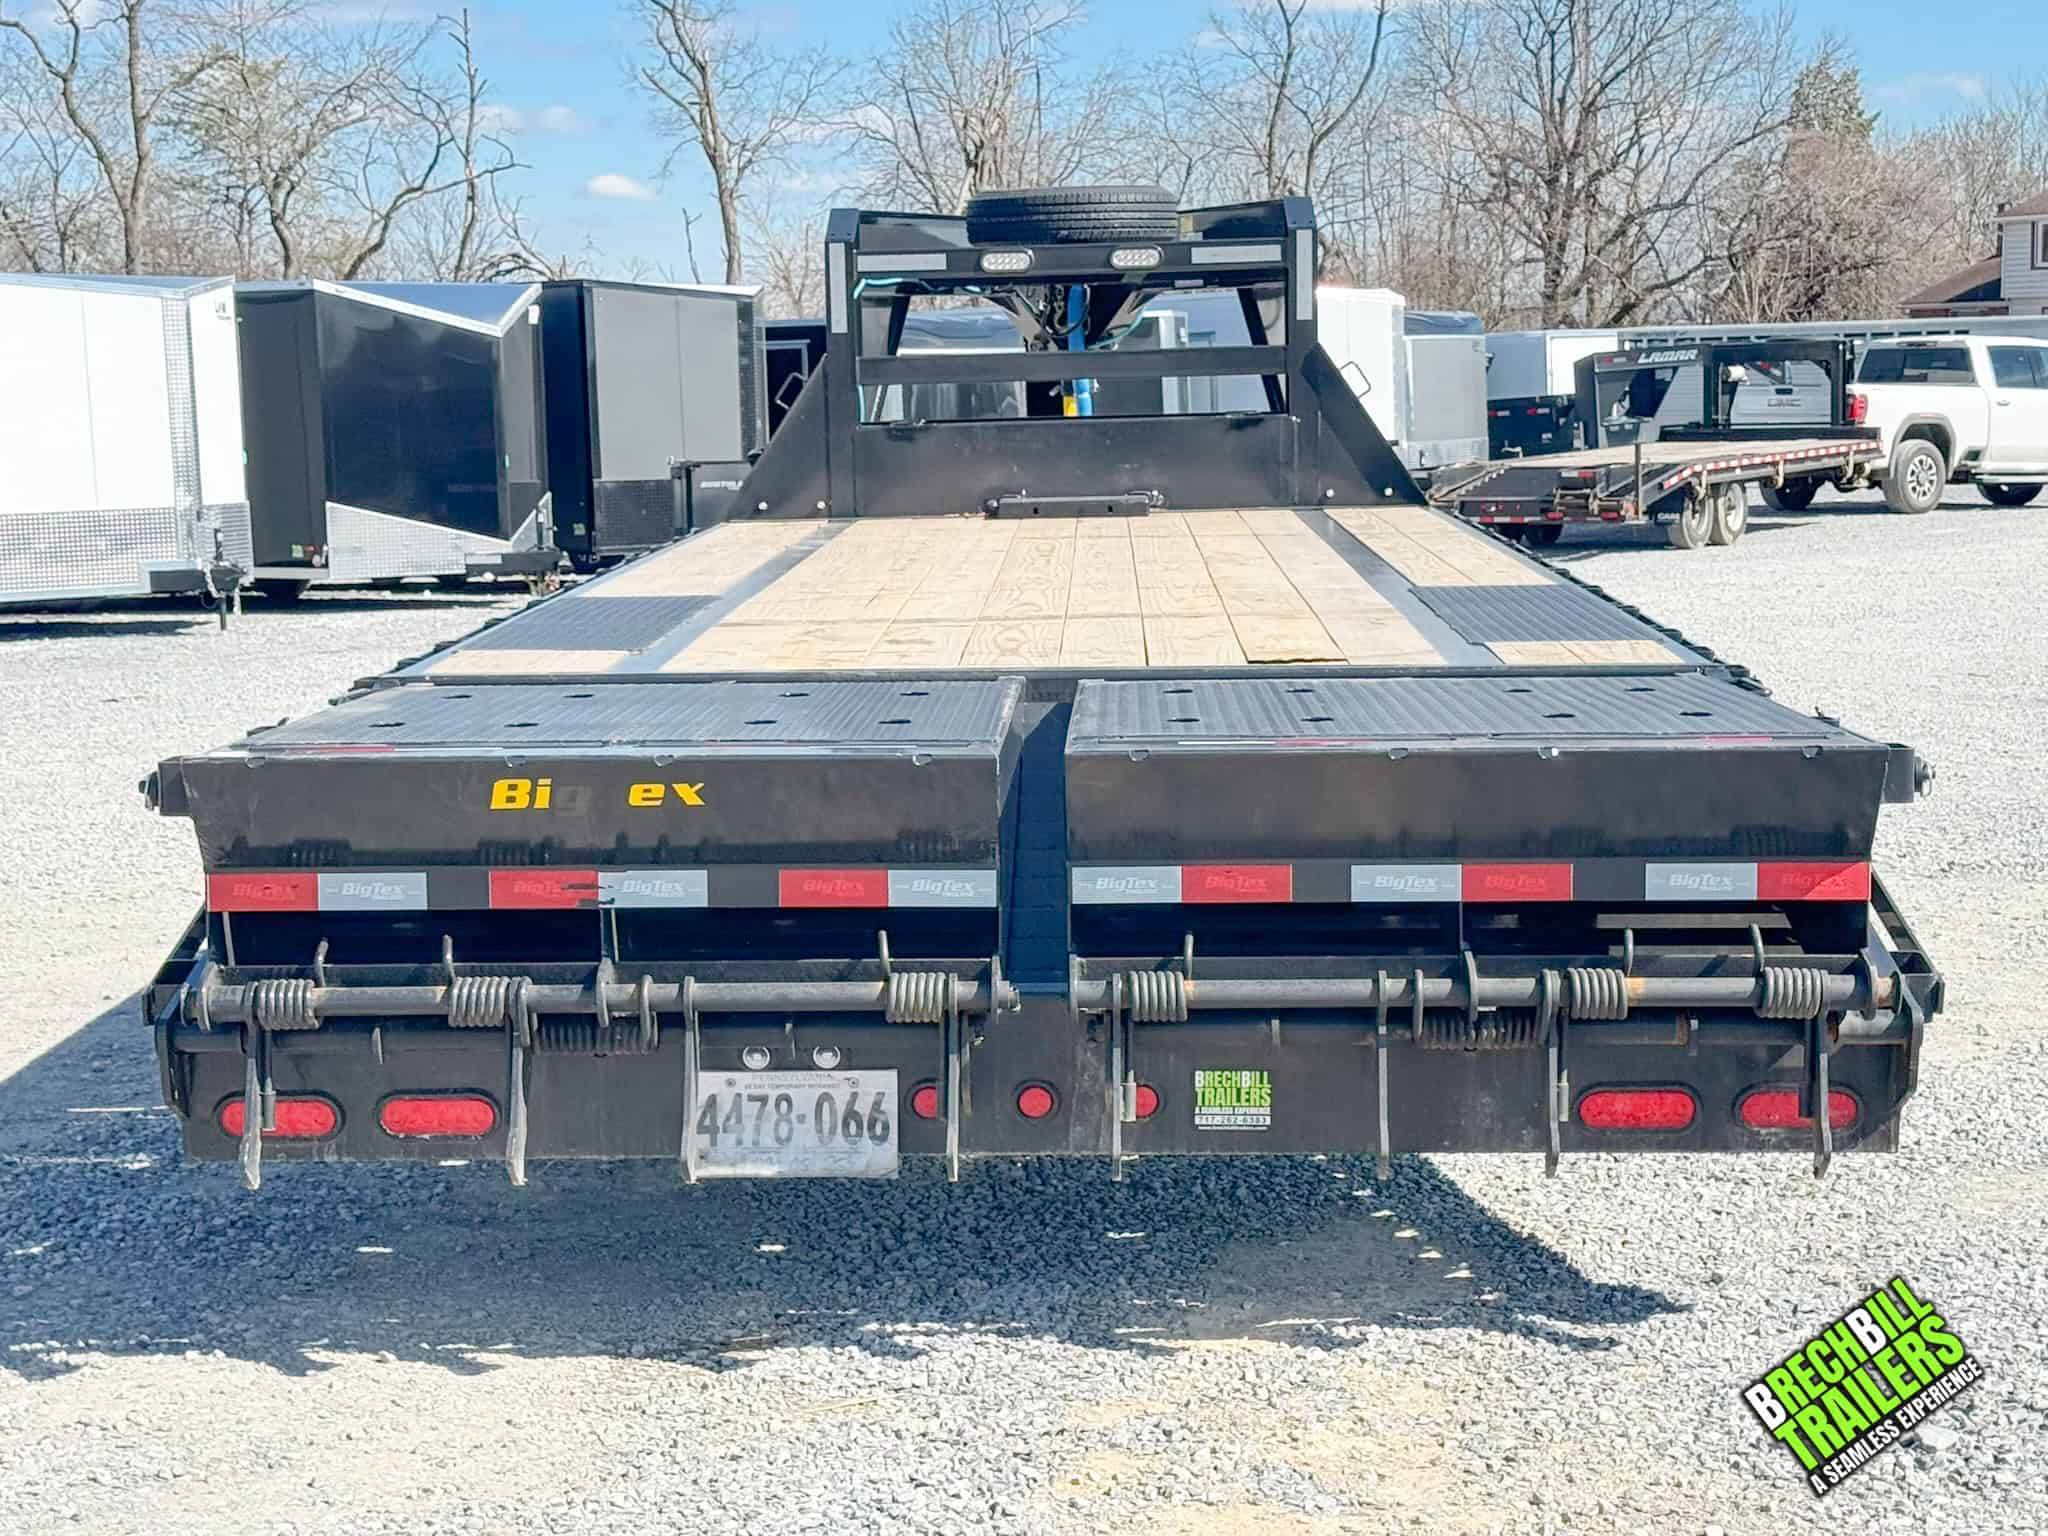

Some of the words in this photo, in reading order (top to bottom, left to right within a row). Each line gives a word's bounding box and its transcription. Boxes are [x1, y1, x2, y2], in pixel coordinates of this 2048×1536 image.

[1637, 349, 1699, 364] LAMAR
[911, 878, 976, 895] BigTex
[1095, 876, 1160, 892] BigTex
[1374, 874, 1439, 891] BigTex
[1669, 873, 1733, 889] BigTex
[341, 882, 408, 898] BigTex
[1194, 1070, 1272, 1088] BRECHBILL
[1194, 1087, 1272, 1106] TRAILERS
[696, 1091, 891, 1147] 4478-066
